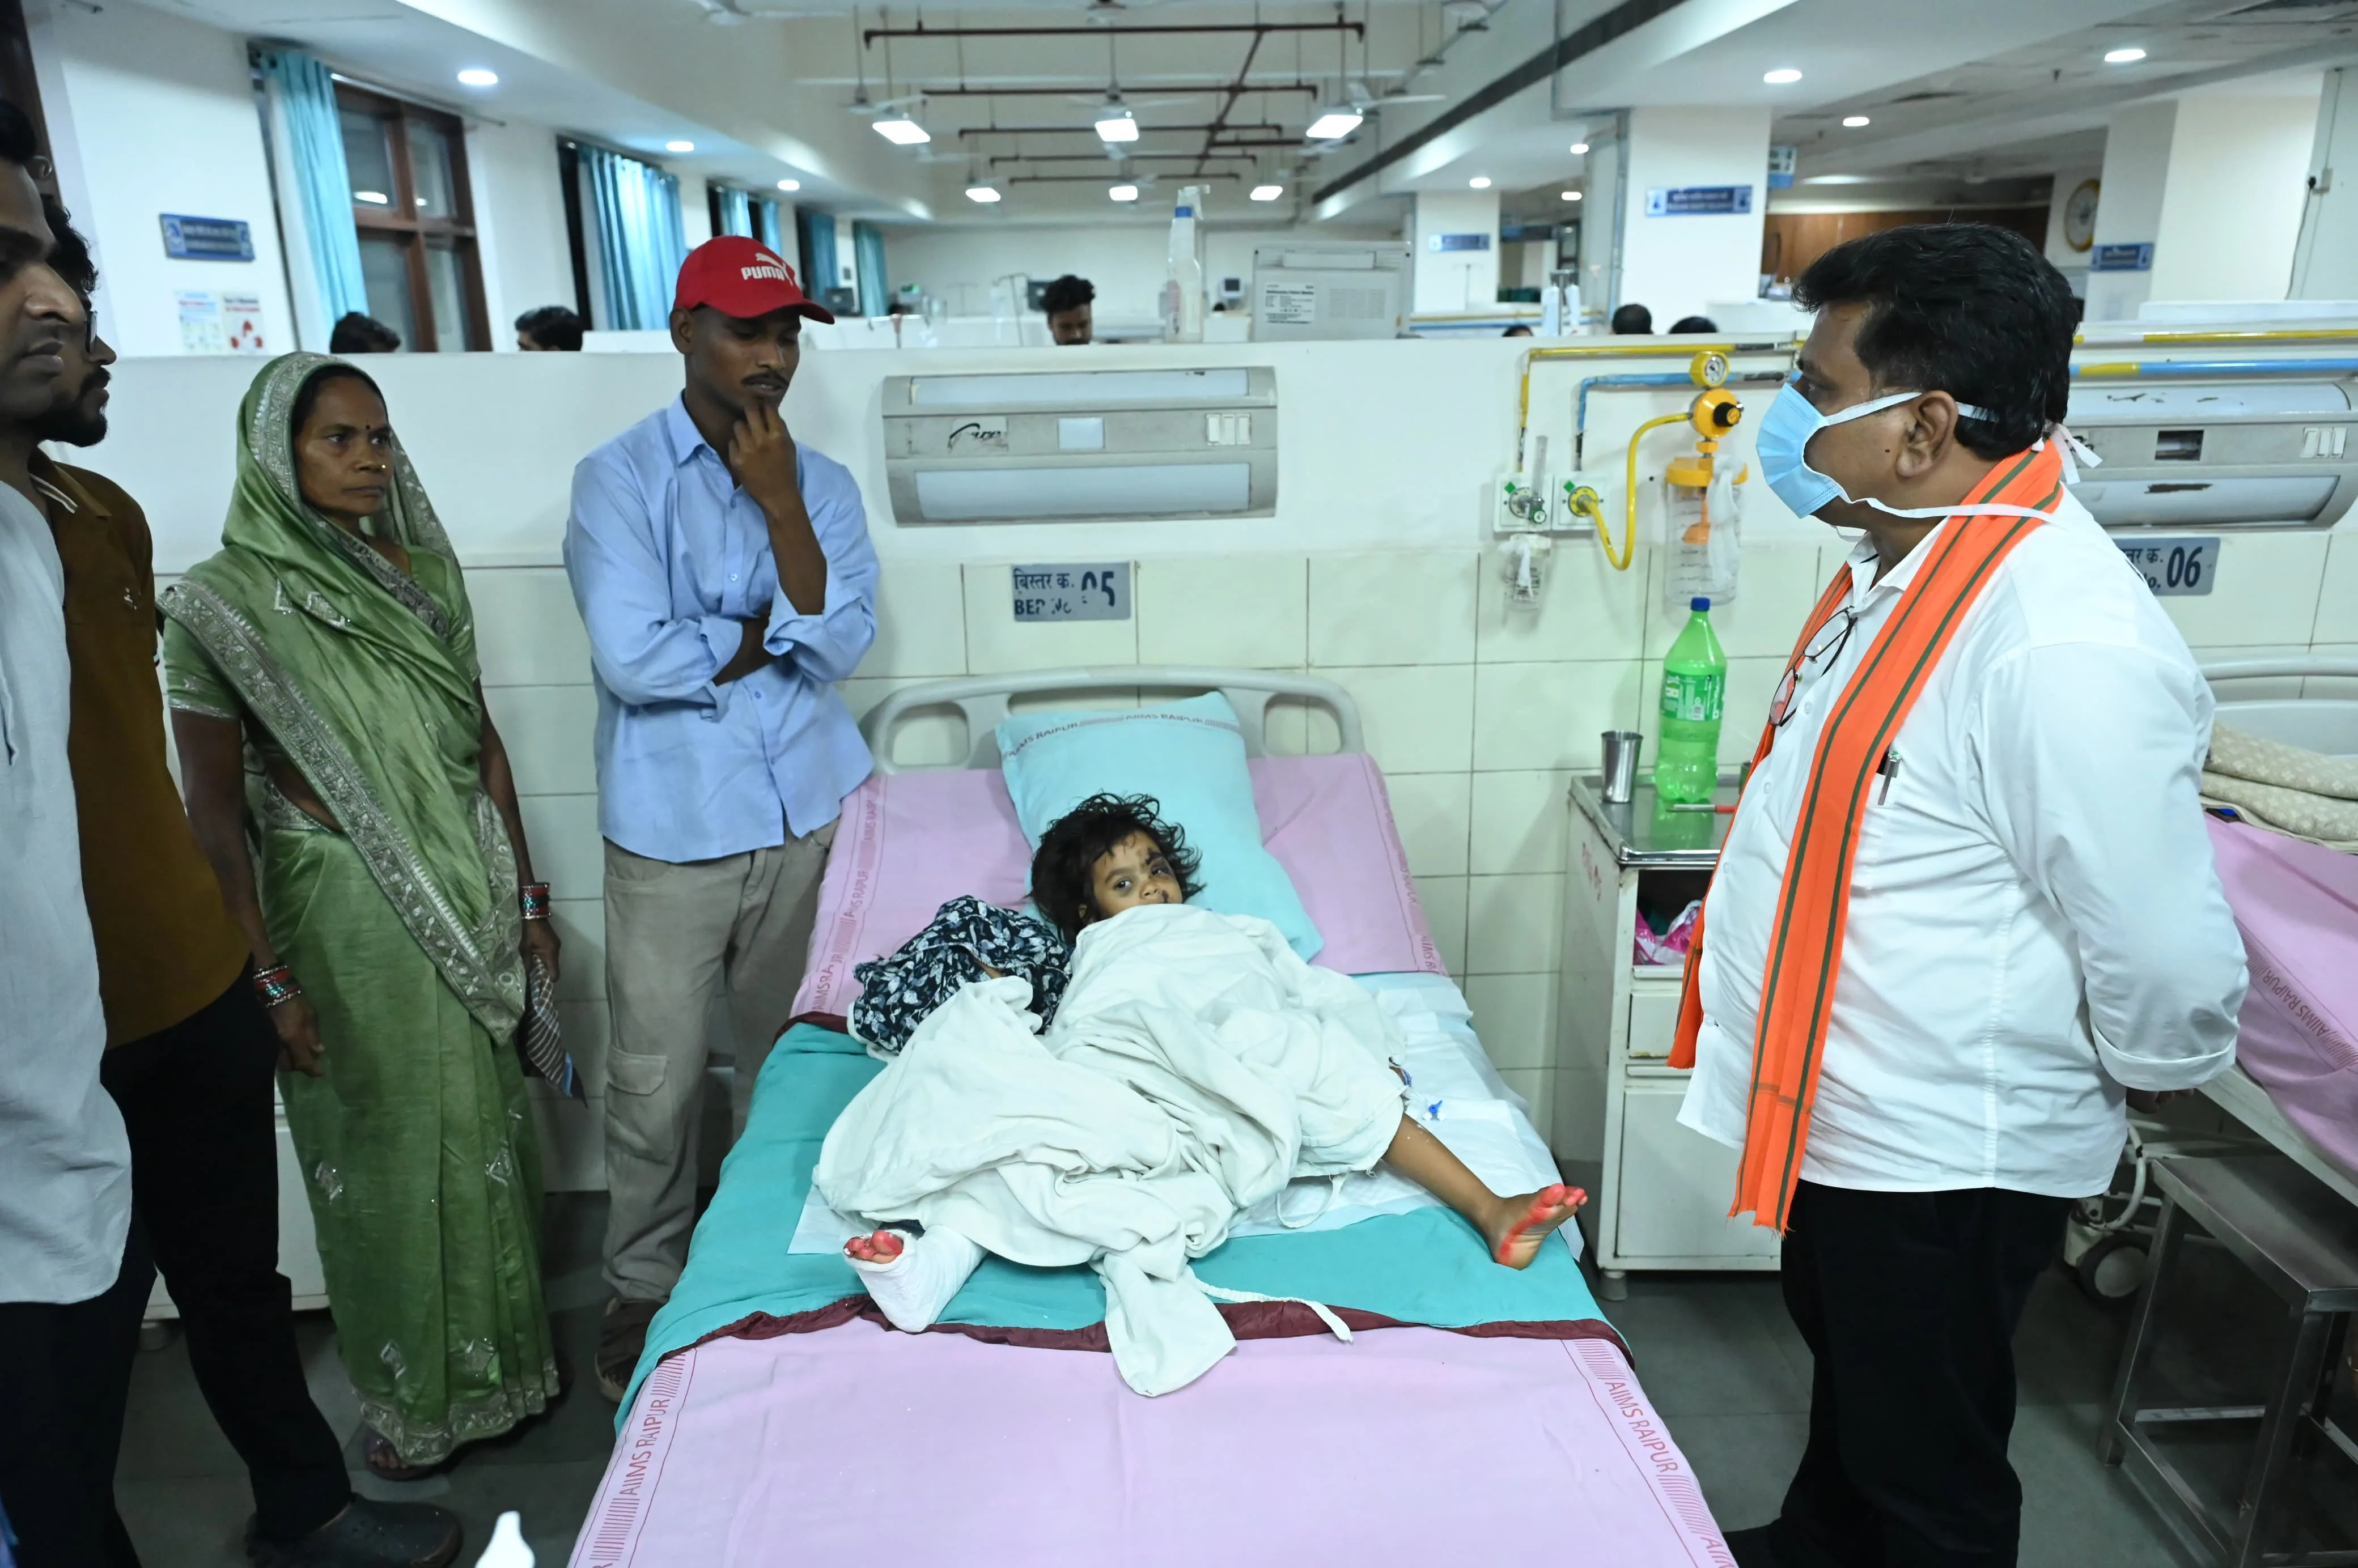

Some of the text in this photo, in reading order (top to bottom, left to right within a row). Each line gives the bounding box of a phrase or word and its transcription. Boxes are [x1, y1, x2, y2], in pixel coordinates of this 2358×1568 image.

[741, 265, 785, 281] PUMA
[1013, 568, 1053, 590] बिस्तर
[2166, 546, 2203, 588] 06
[1036, 721, 1078, 740] RAIPUR
[1161, 712, 1203, 724] RAIPUR
[2263, 970, 2330, 1037] AIIMS RAIPUR
[1605, 1382, 1678, 1473] AIIMS RAIPUR
[619, 1399, 671, 1495] AIIMS RAIPUR
